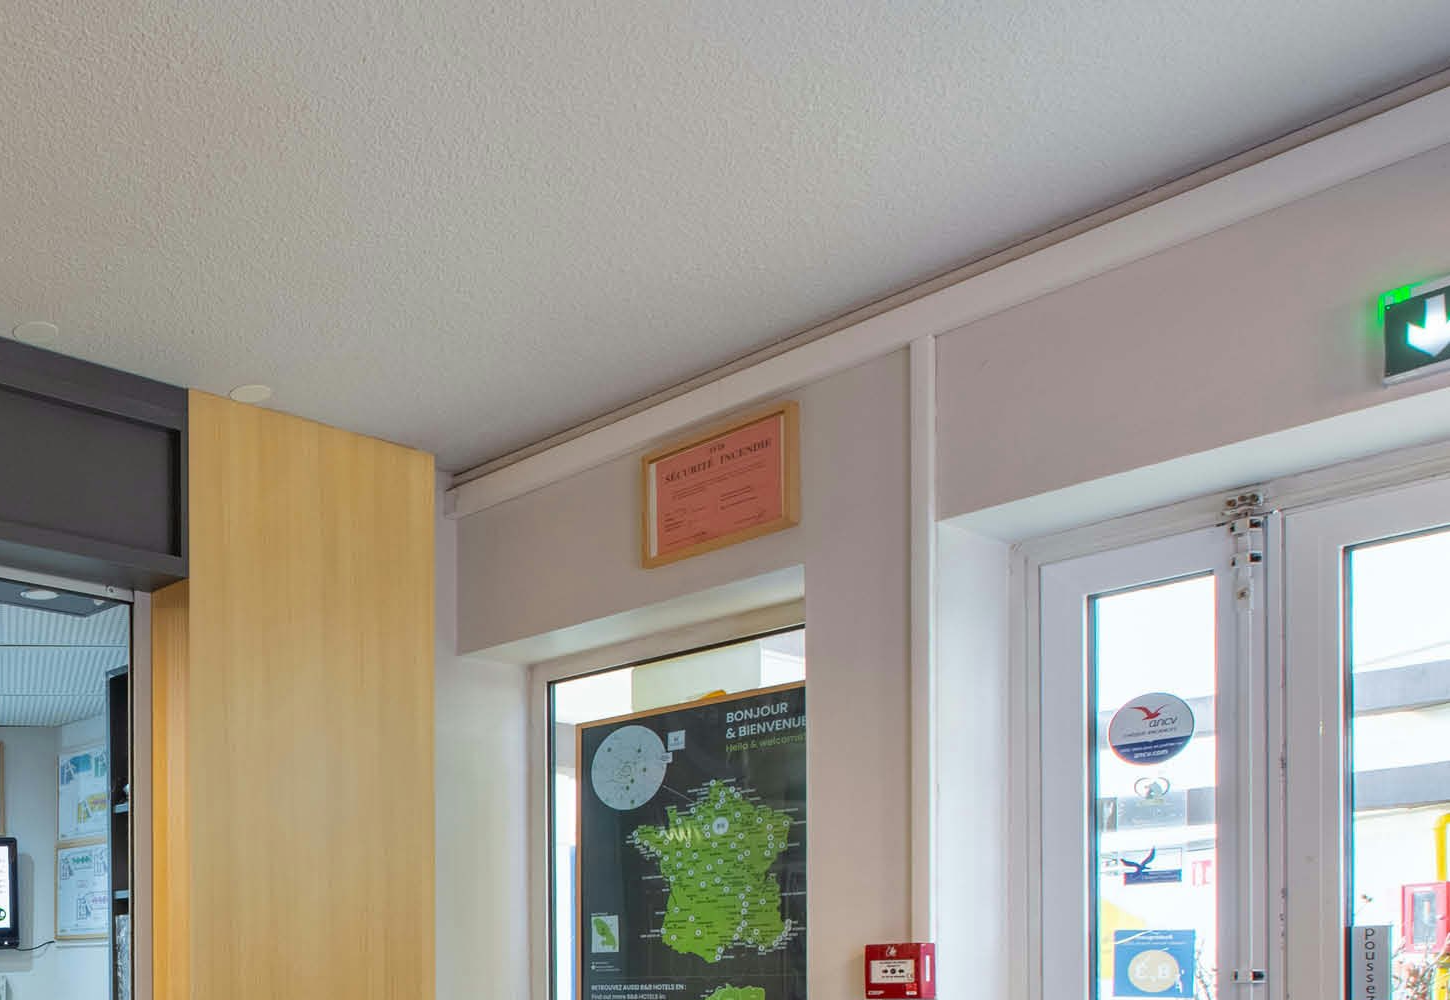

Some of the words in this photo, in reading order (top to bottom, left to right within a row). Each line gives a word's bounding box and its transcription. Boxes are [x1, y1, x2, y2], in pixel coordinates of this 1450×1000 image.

[726, 702, 788, 723] BONJOUR
[1149, 716, 1178, 728] ancv
[726, 727, 736, 739] &
